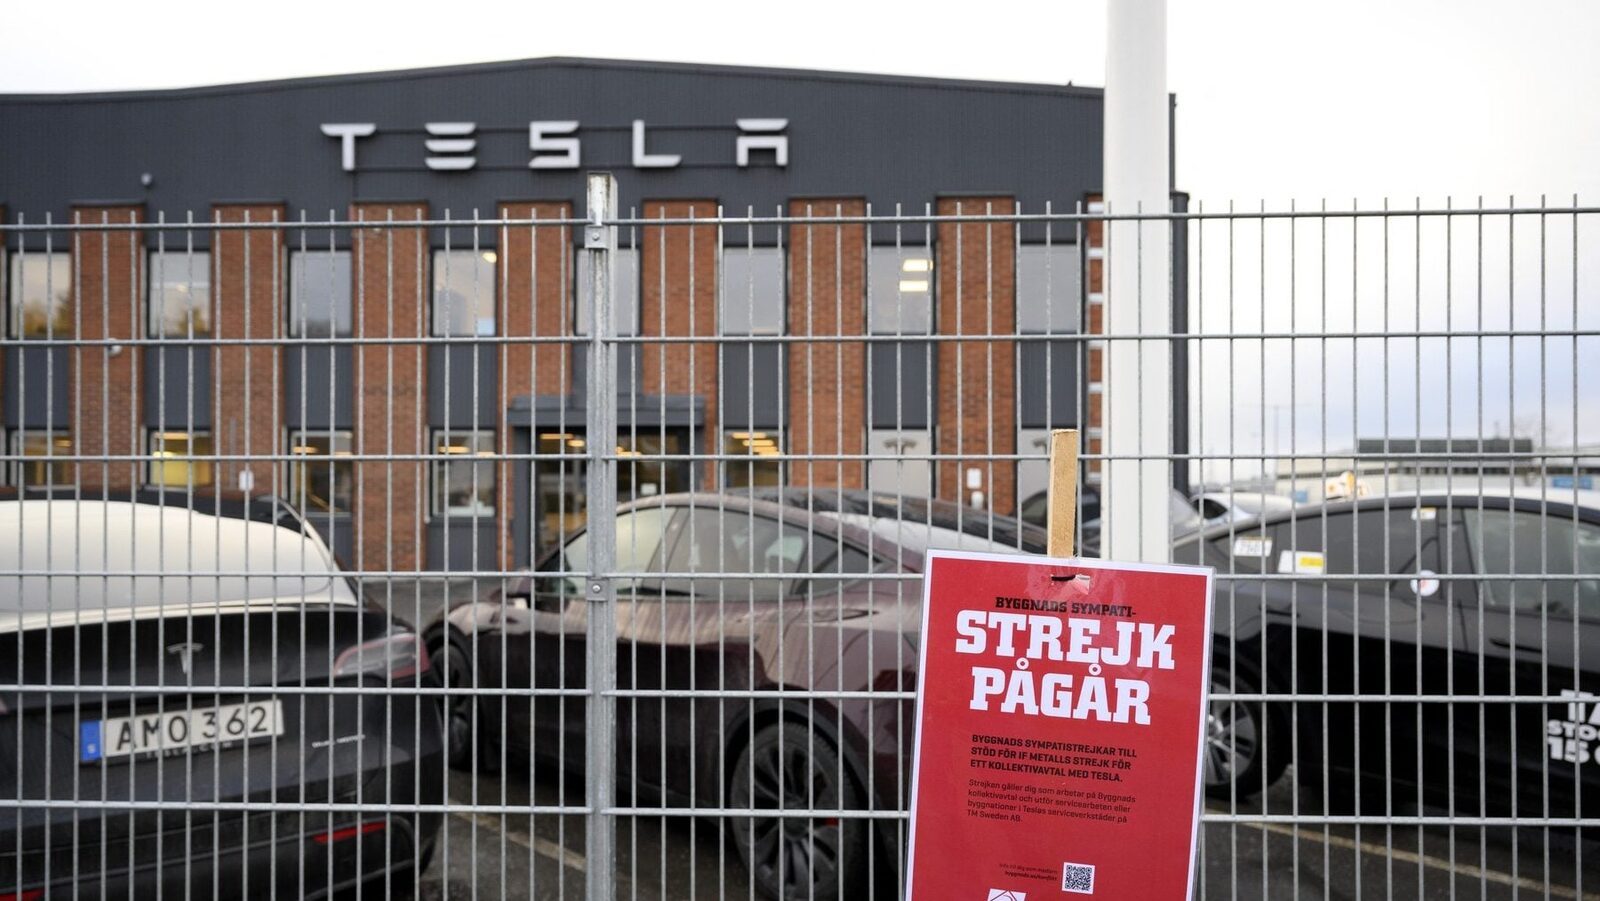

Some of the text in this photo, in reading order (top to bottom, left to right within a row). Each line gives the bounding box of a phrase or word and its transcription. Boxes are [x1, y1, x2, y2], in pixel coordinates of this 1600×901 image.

[320, 118, 788, 171] TESLA
[995, 596, 1136, 617] BYGGNADS SYMPATI-
[955, 609, 1176, 670] STREJK
[969, 657, 1151, 725] PÅGÅR
[202, 706, 268, 738] 362
[1548, 719, 1600, 741] STO
[971, 746, 1131, 770] STÖD FÖR IF METALLS STREJK FÖR
[972, 734, 1137, 758] BYGGNADS SYMPATISTREJKAR TILL
[970, 759, 1123, 782] ETT KOLLEKTIVAVTAL MED TESLA.
[968, 789, 1131, 813] kollektivavtal och utför servicearbeten eller
[969, 779, 1136, 803] Strejken gäller dig som arbetar på Byggnads
[967, 809, 1022, 822] TM Sweden AB.
[968, 799, 1017, 812] byggnationer
[1023, 805, 1046, 815] Teslas
[1047, 808, 1116, 822] serviceverkstäder
[1117, 816, 1127, 824] på
